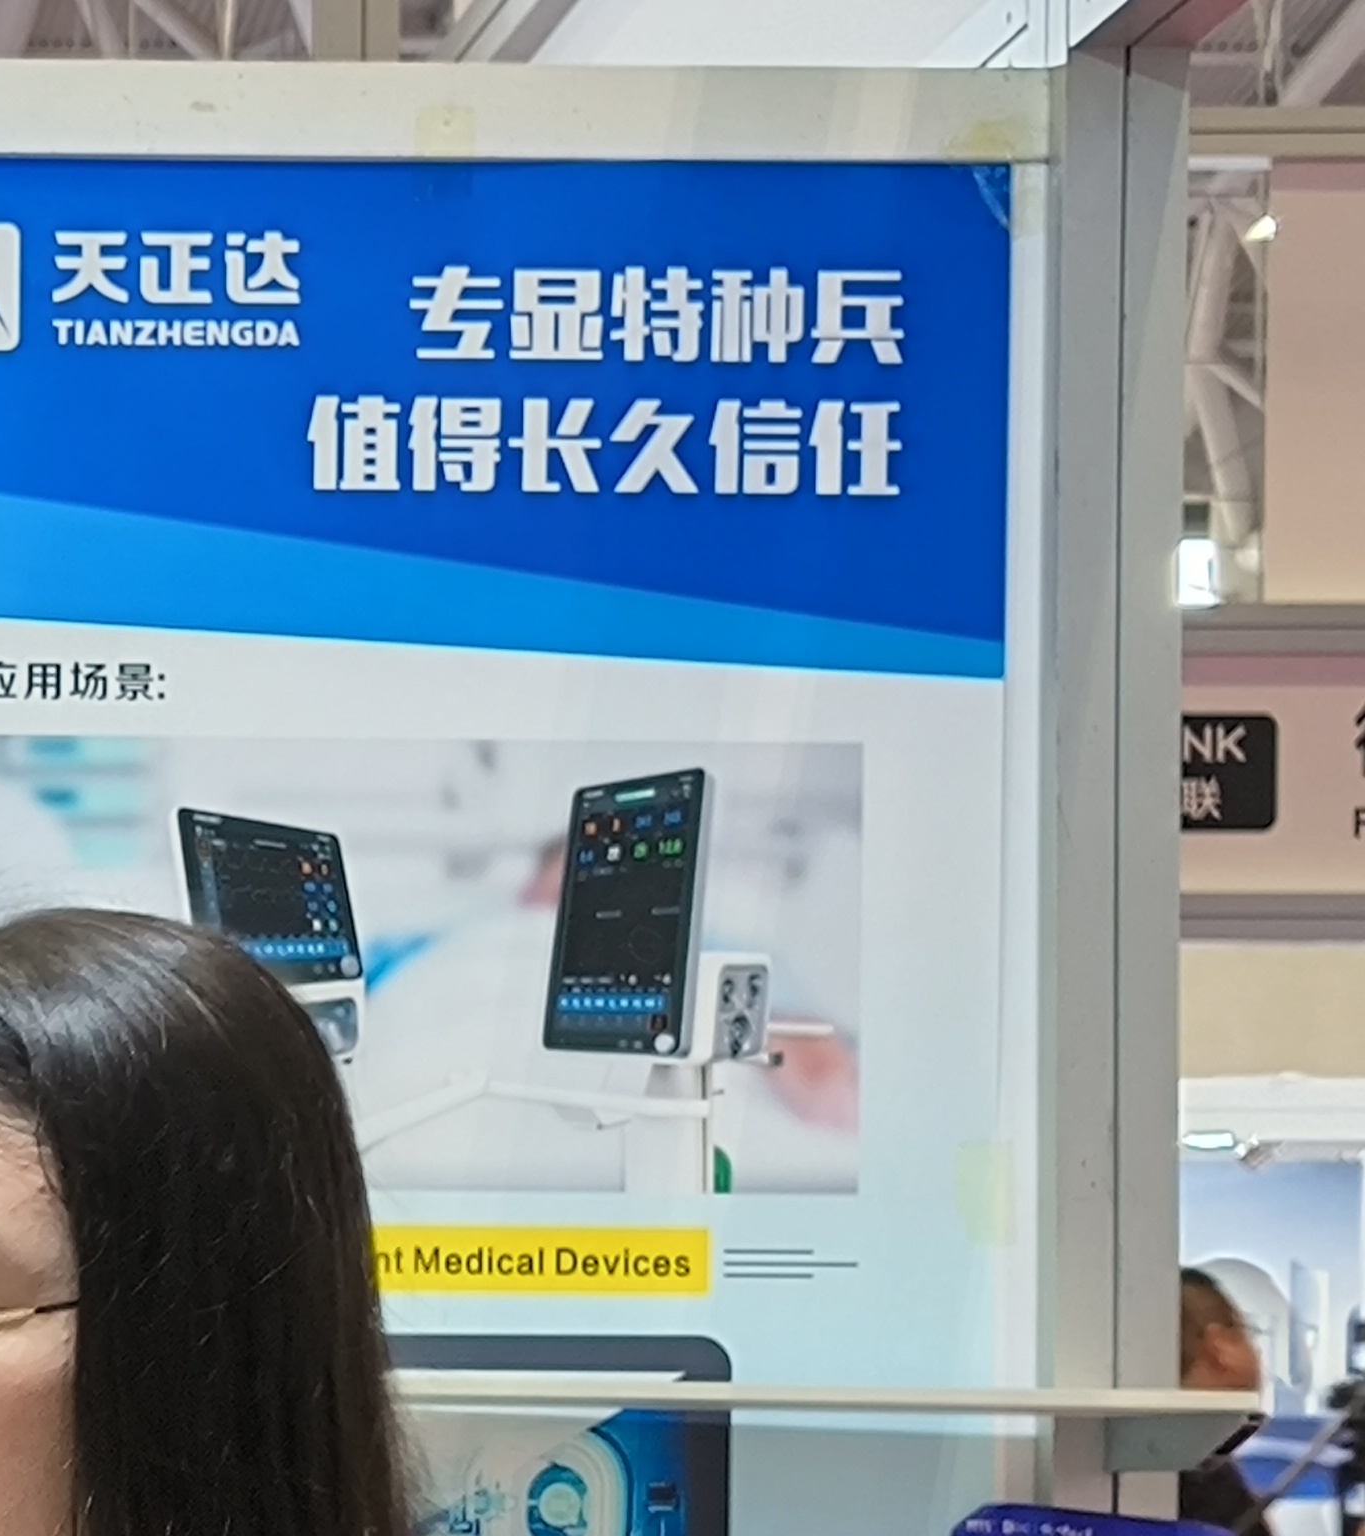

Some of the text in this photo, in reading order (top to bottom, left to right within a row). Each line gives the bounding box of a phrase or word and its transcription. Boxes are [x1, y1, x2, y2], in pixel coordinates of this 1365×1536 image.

[51, 230, 302, 307] 天正达
[52, 320, 300, 349] TIANZHENGDA
[408, 266, 905, 366] 专显特种兵
[306, 394, 903, 497] 值得长久信任
[414, 1246, 545, 1276] Medical
[555, 1248, 691, 1277] Devices
